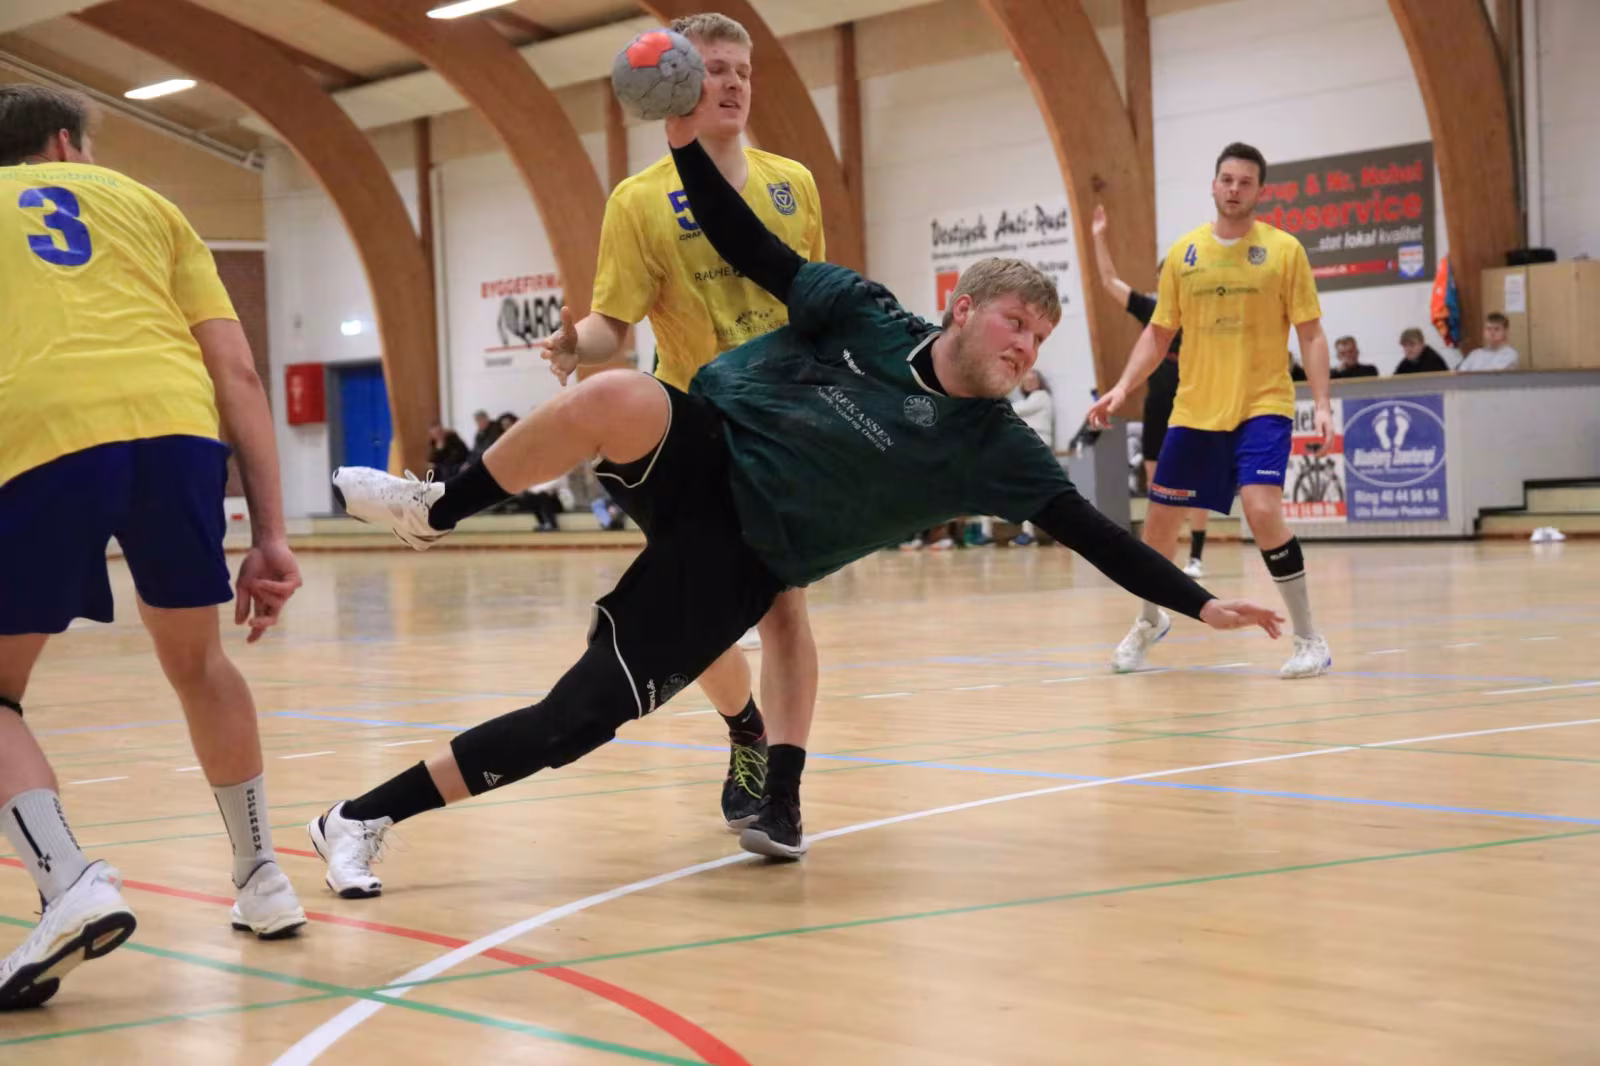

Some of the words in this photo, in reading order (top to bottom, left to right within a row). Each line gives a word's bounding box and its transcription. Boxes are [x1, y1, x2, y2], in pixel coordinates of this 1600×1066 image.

[18, 186, 93, 267] 3
[667, 190, 701, 231] 5
[1256, 191, 1421, 231] utoservice
[1184, 244, 1198, 266] 4
[1344, 228, 1377, 249] lokal
[1378, 224, 1424, 244] kvalitet
